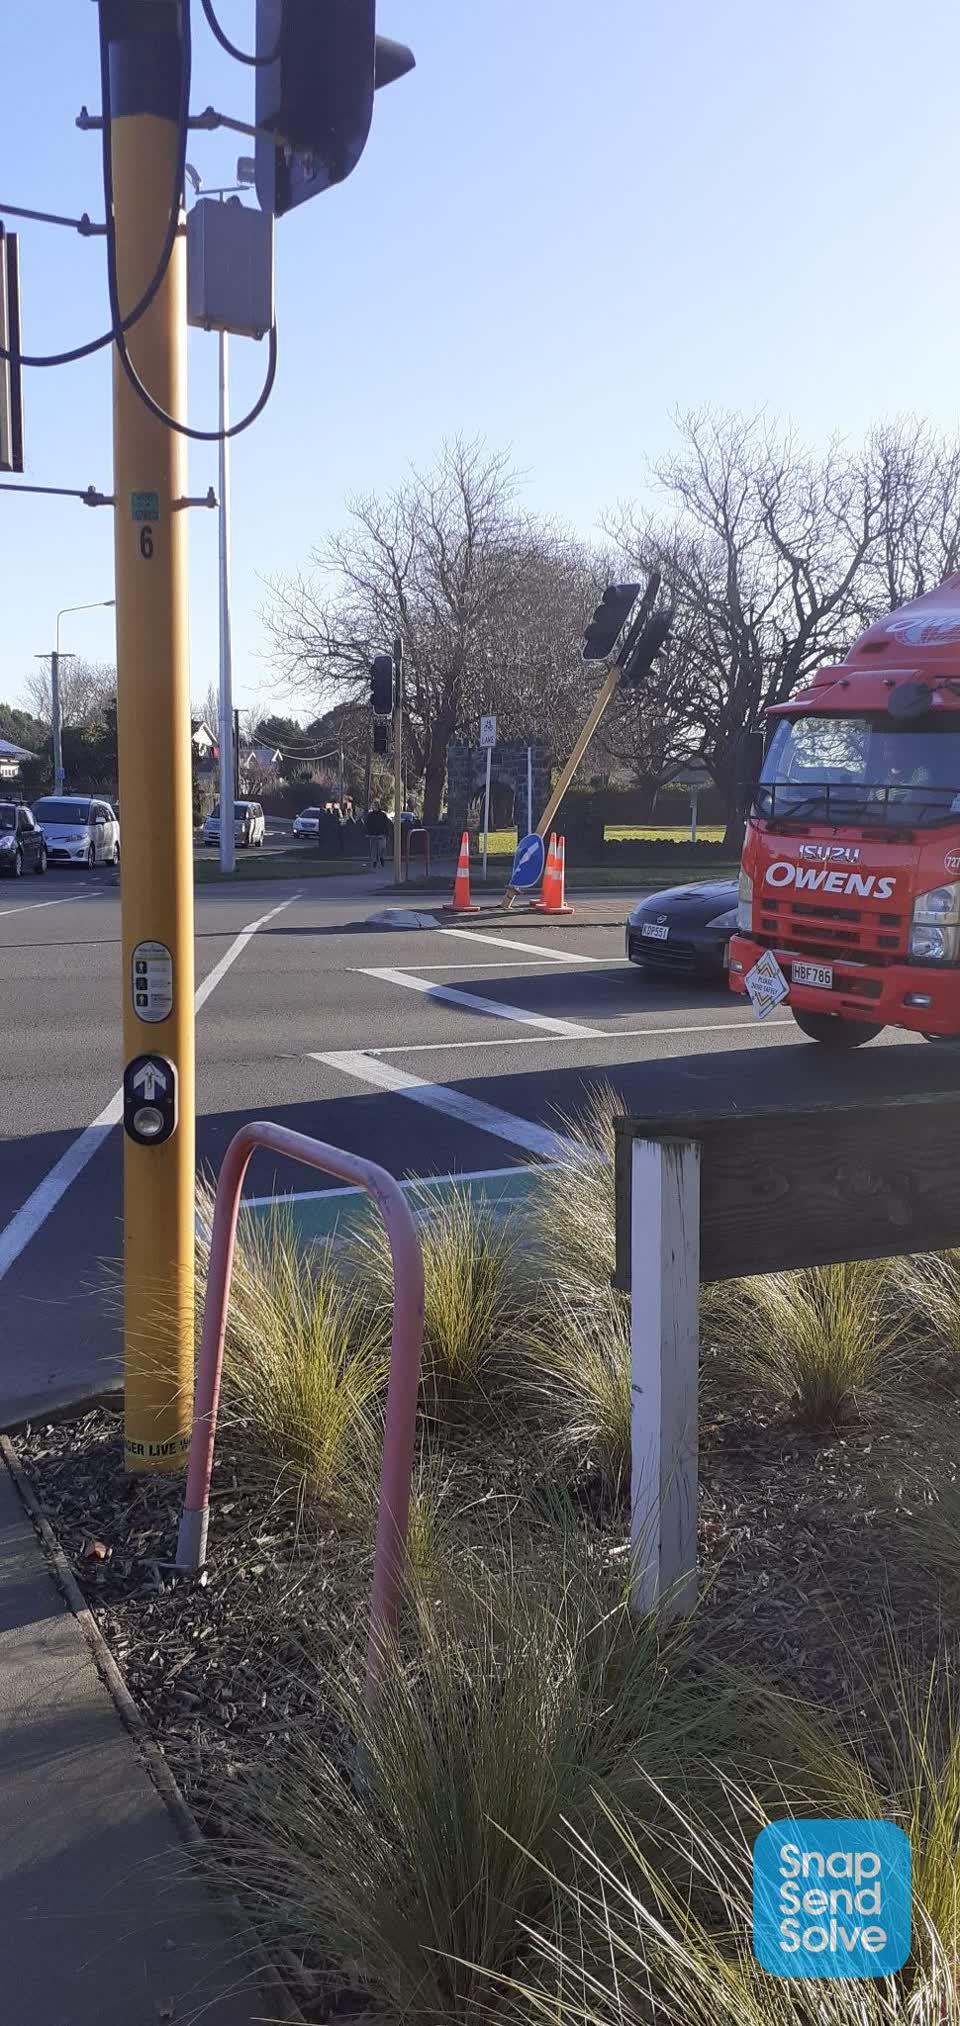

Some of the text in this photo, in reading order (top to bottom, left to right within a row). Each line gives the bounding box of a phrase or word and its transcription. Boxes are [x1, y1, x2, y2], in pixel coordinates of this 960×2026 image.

[140, 525, 154, 559] 6
[799, 844, 860, 863] ISUZU
[765, 862, 897, 899] OWENS
[794, 964, 831, 984] HBF786
[149, 1442, 177, 1456] LIVE
